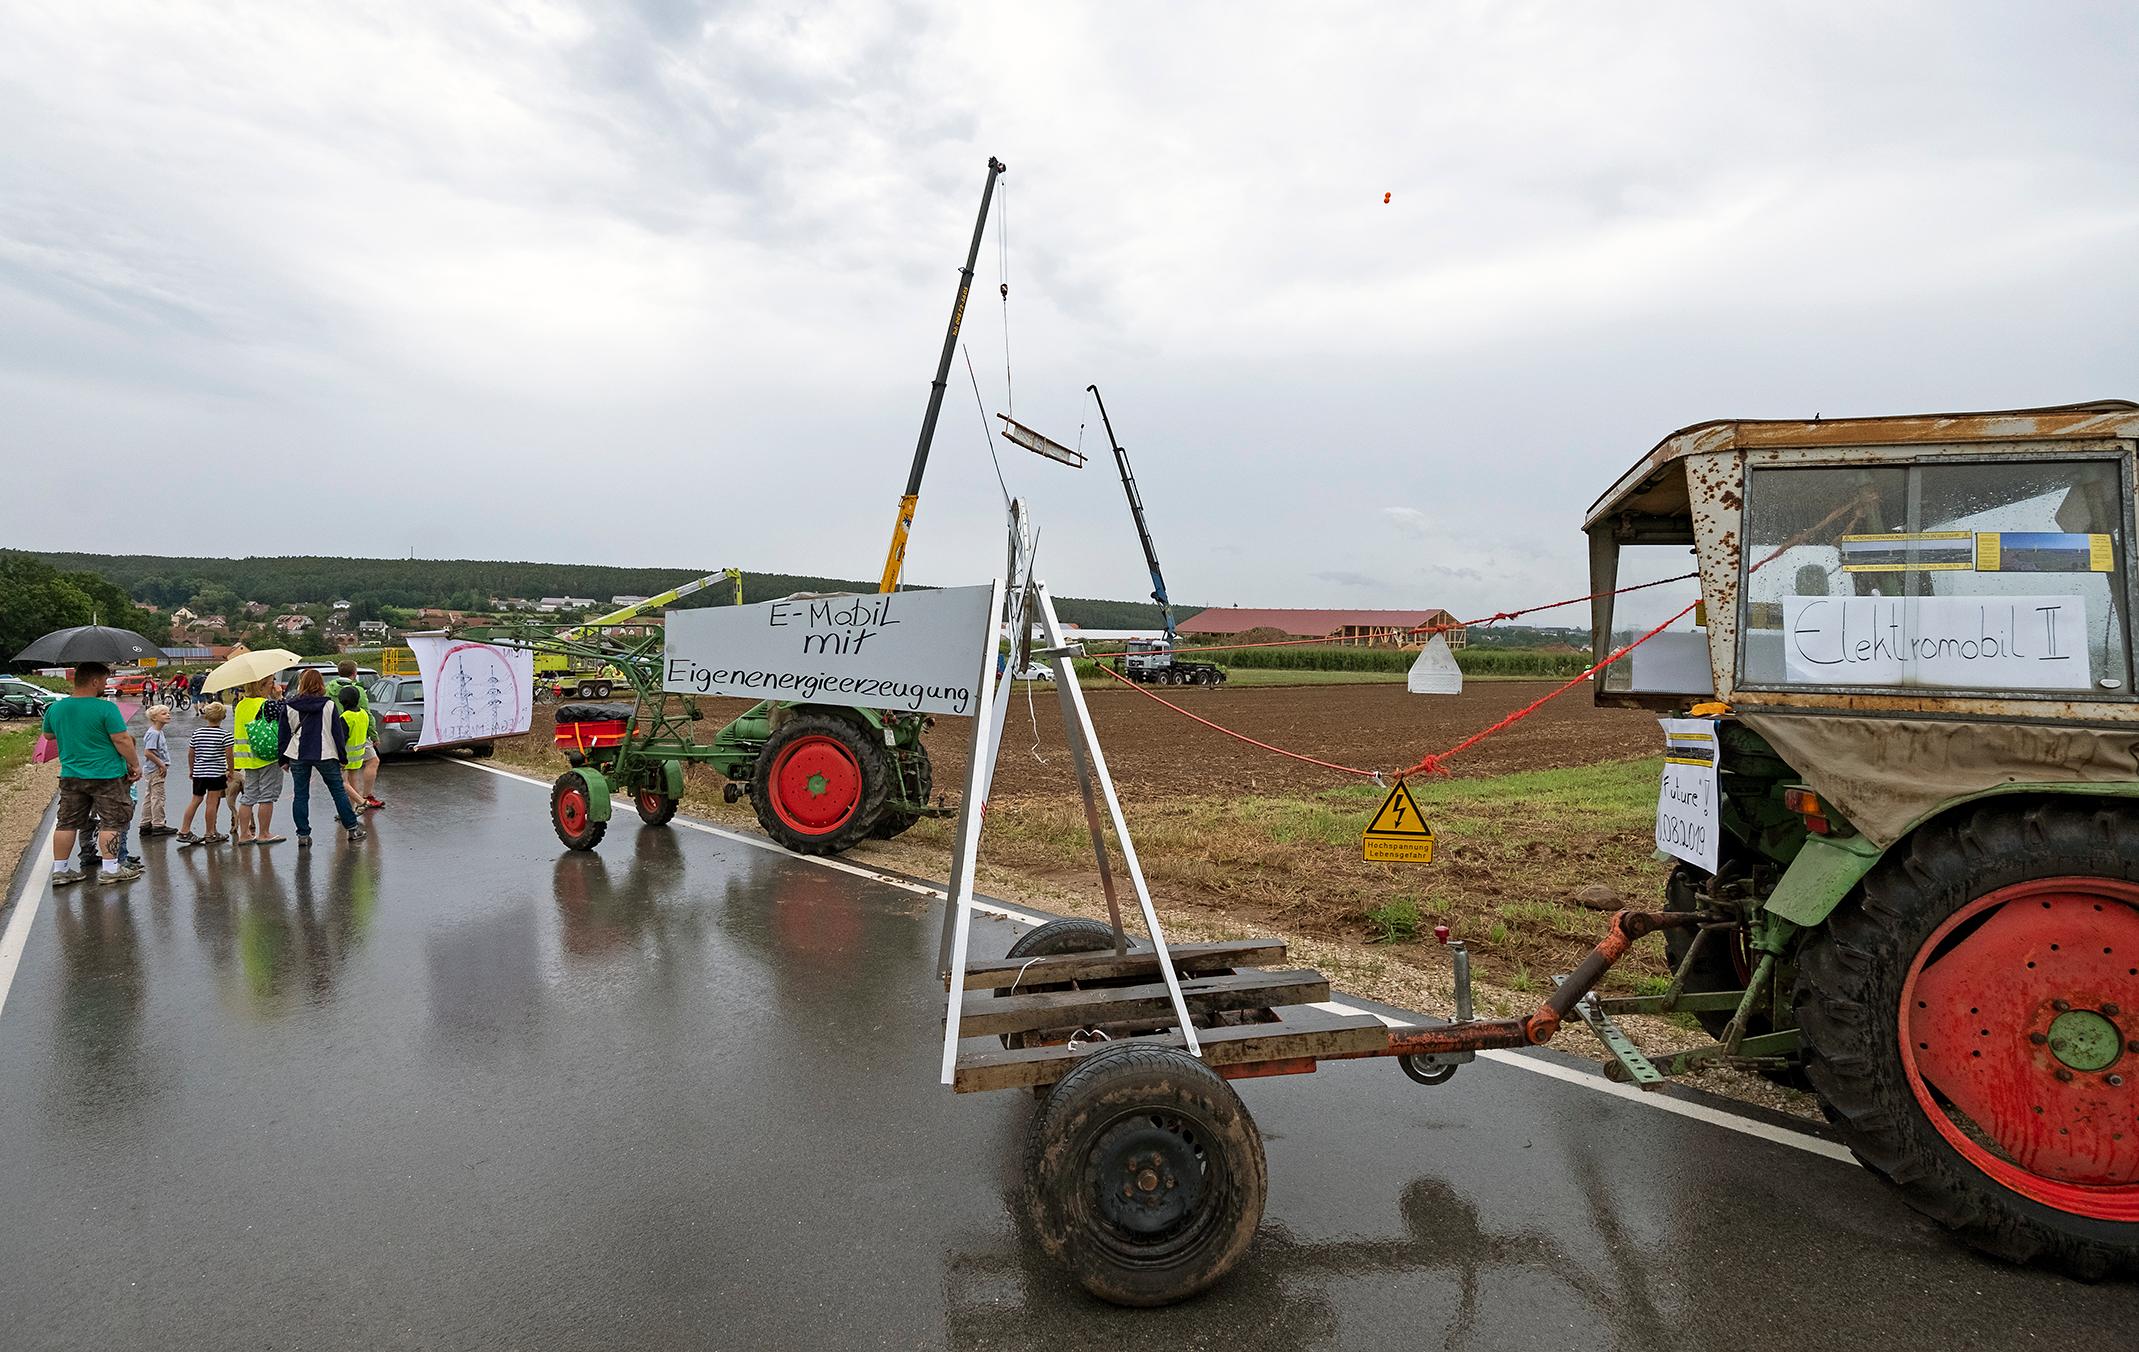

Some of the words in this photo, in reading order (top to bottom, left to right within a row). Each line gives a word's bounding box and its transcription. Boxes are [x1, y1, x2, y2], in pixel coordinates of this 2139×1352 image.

[803, 629, 877, 655] mit
[1794, 600, 2025, 664] Elektromobil
[668, 659, 970, 713] Eigenenergieerzeugung
[1367, 842, 1429, 852] Hochspannung
[1370, 850, 1426, 859] Lebensgefahr
